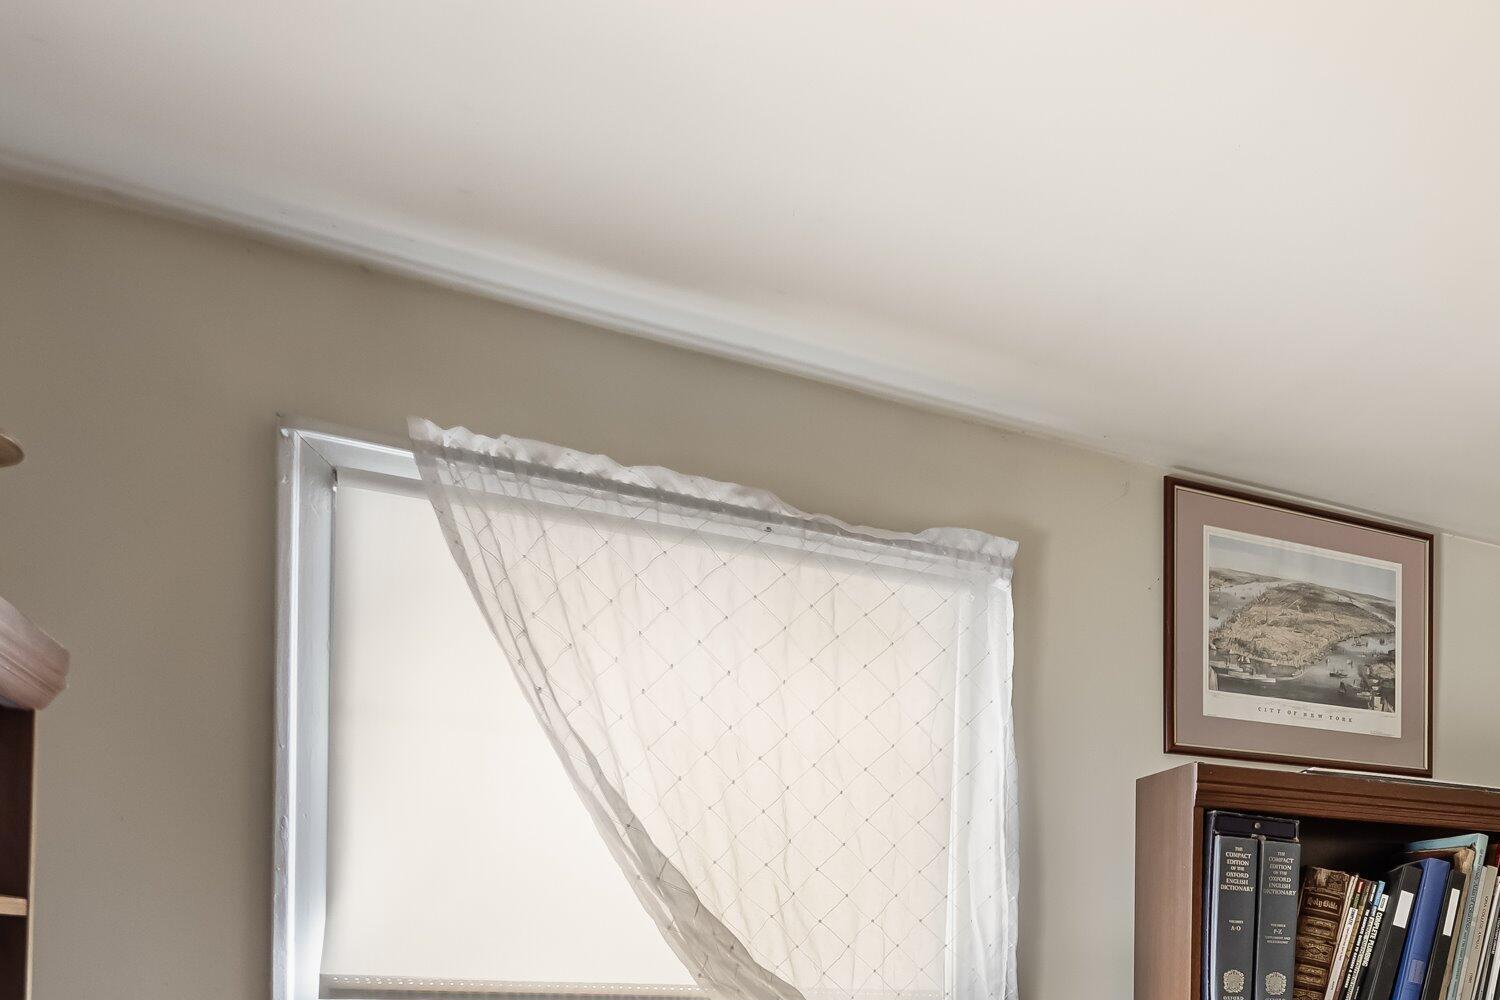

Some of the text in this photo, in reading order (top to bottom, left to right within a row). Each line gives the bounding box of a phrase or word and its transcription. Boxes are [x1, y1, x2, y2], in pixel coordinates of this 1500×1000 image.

[1258, 706, 1281, 714] CITY
[1329, 715, 1353, 723] YORK
[1221, 884, 1254, 892] DICTIONARY
[1369, 911, 1383, 939] COMPLETE
[1360, 939, 1374, 967] PLUMBING
